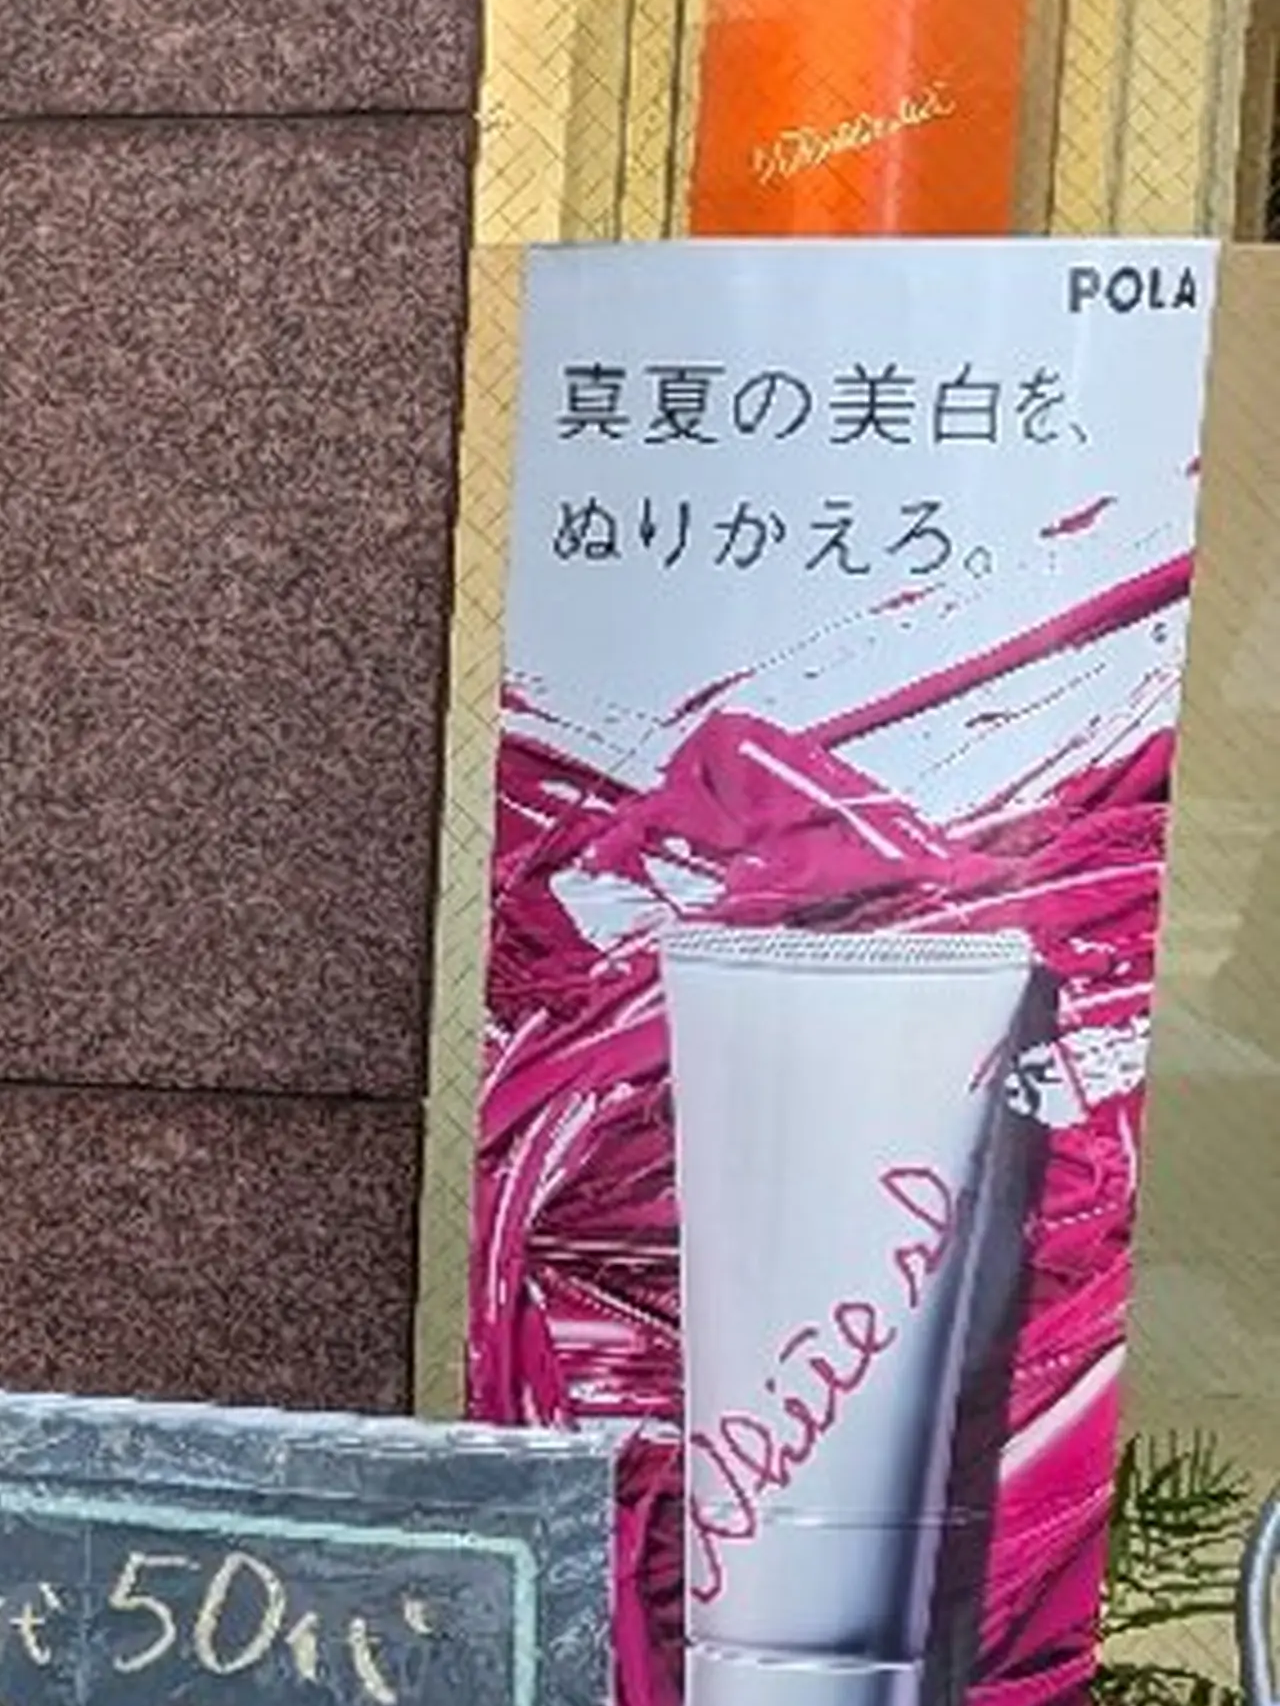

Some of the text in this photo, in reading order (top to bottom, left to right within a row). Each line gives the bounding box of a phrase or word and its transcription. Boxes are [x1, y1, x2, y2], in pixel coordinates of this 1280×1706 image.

[1068, 267, 1198, 315] POLA
[557, 361, 1090, 446] 真夏の美白を、
[552, 496, 994, 577] ぬりかえろ。
[108, 1551, 436, 1706] 50代
